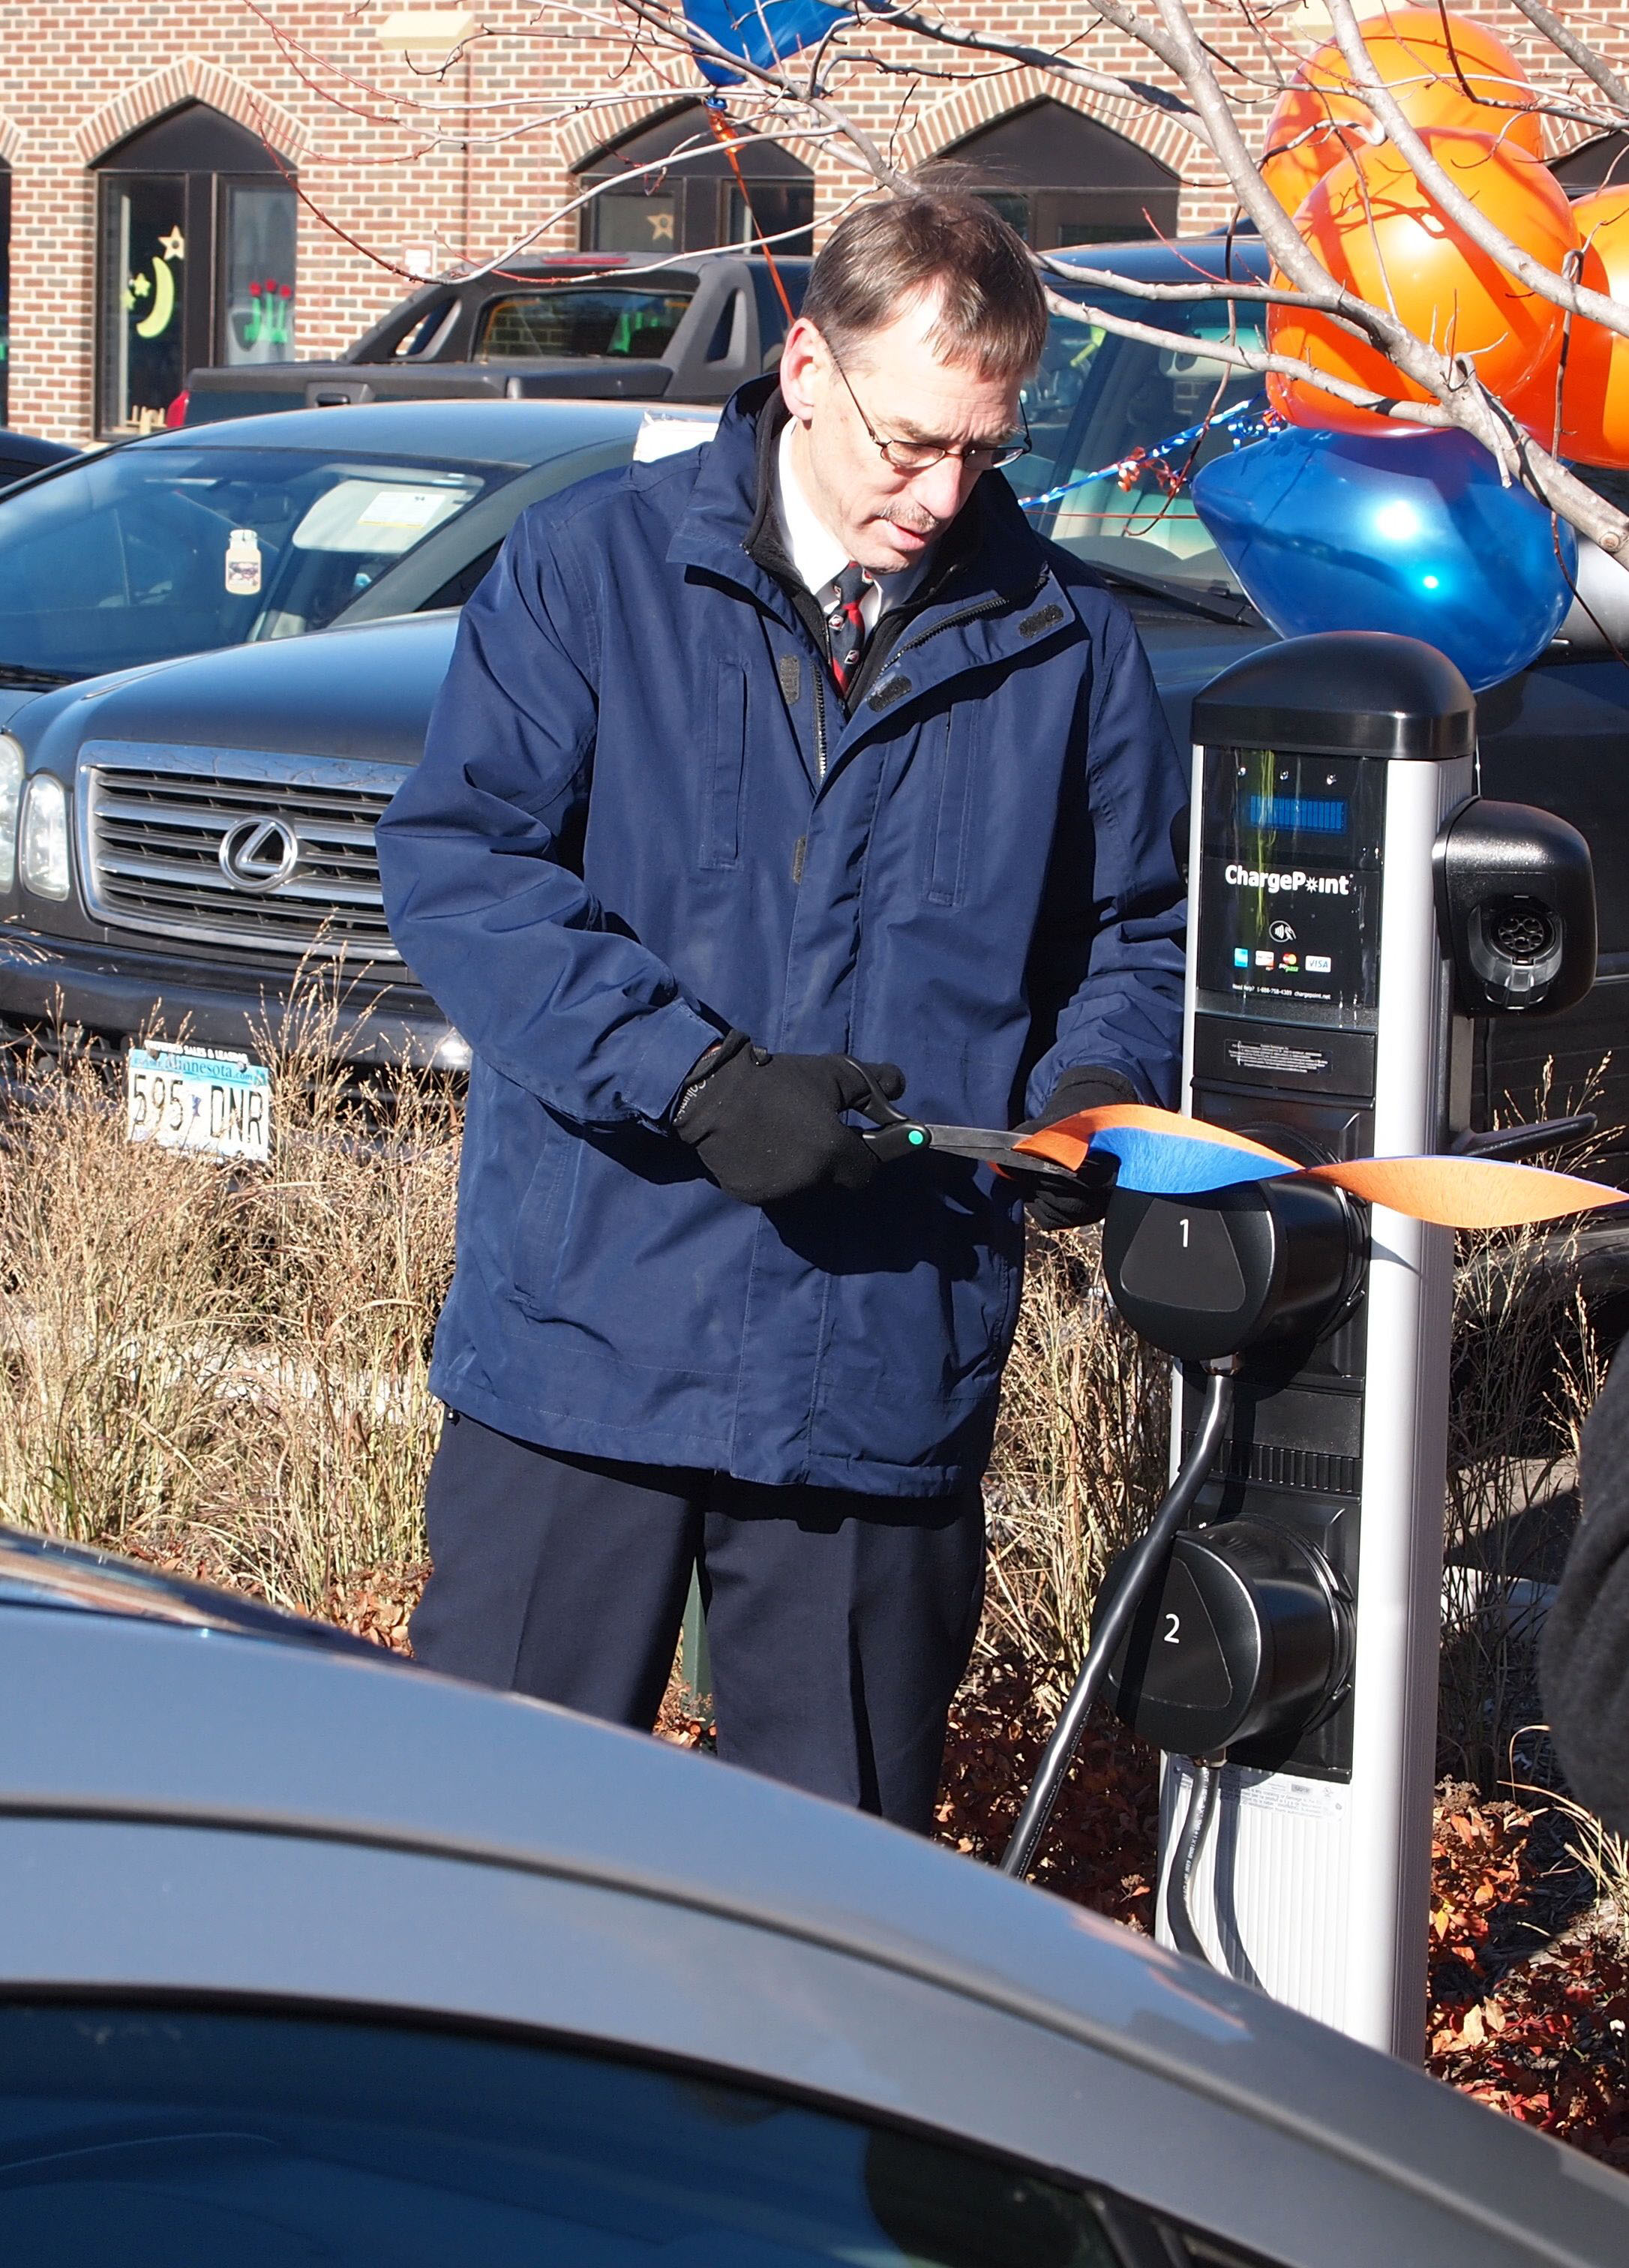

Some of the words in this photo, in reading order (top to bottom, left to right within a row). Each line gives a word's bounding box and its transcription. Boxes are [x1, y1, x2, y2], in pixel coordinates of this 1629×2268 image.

[1225, 864, 1350, 896] ChargePoint
[1310, 959, 1329, 969] VISA
[134, 1073, 183, 1131] 595
[210, 1084, 262, 1144] DNR
[1180, 1219, 1189, 1248] 1
[1164, 1613, 1180, 1643] 2
